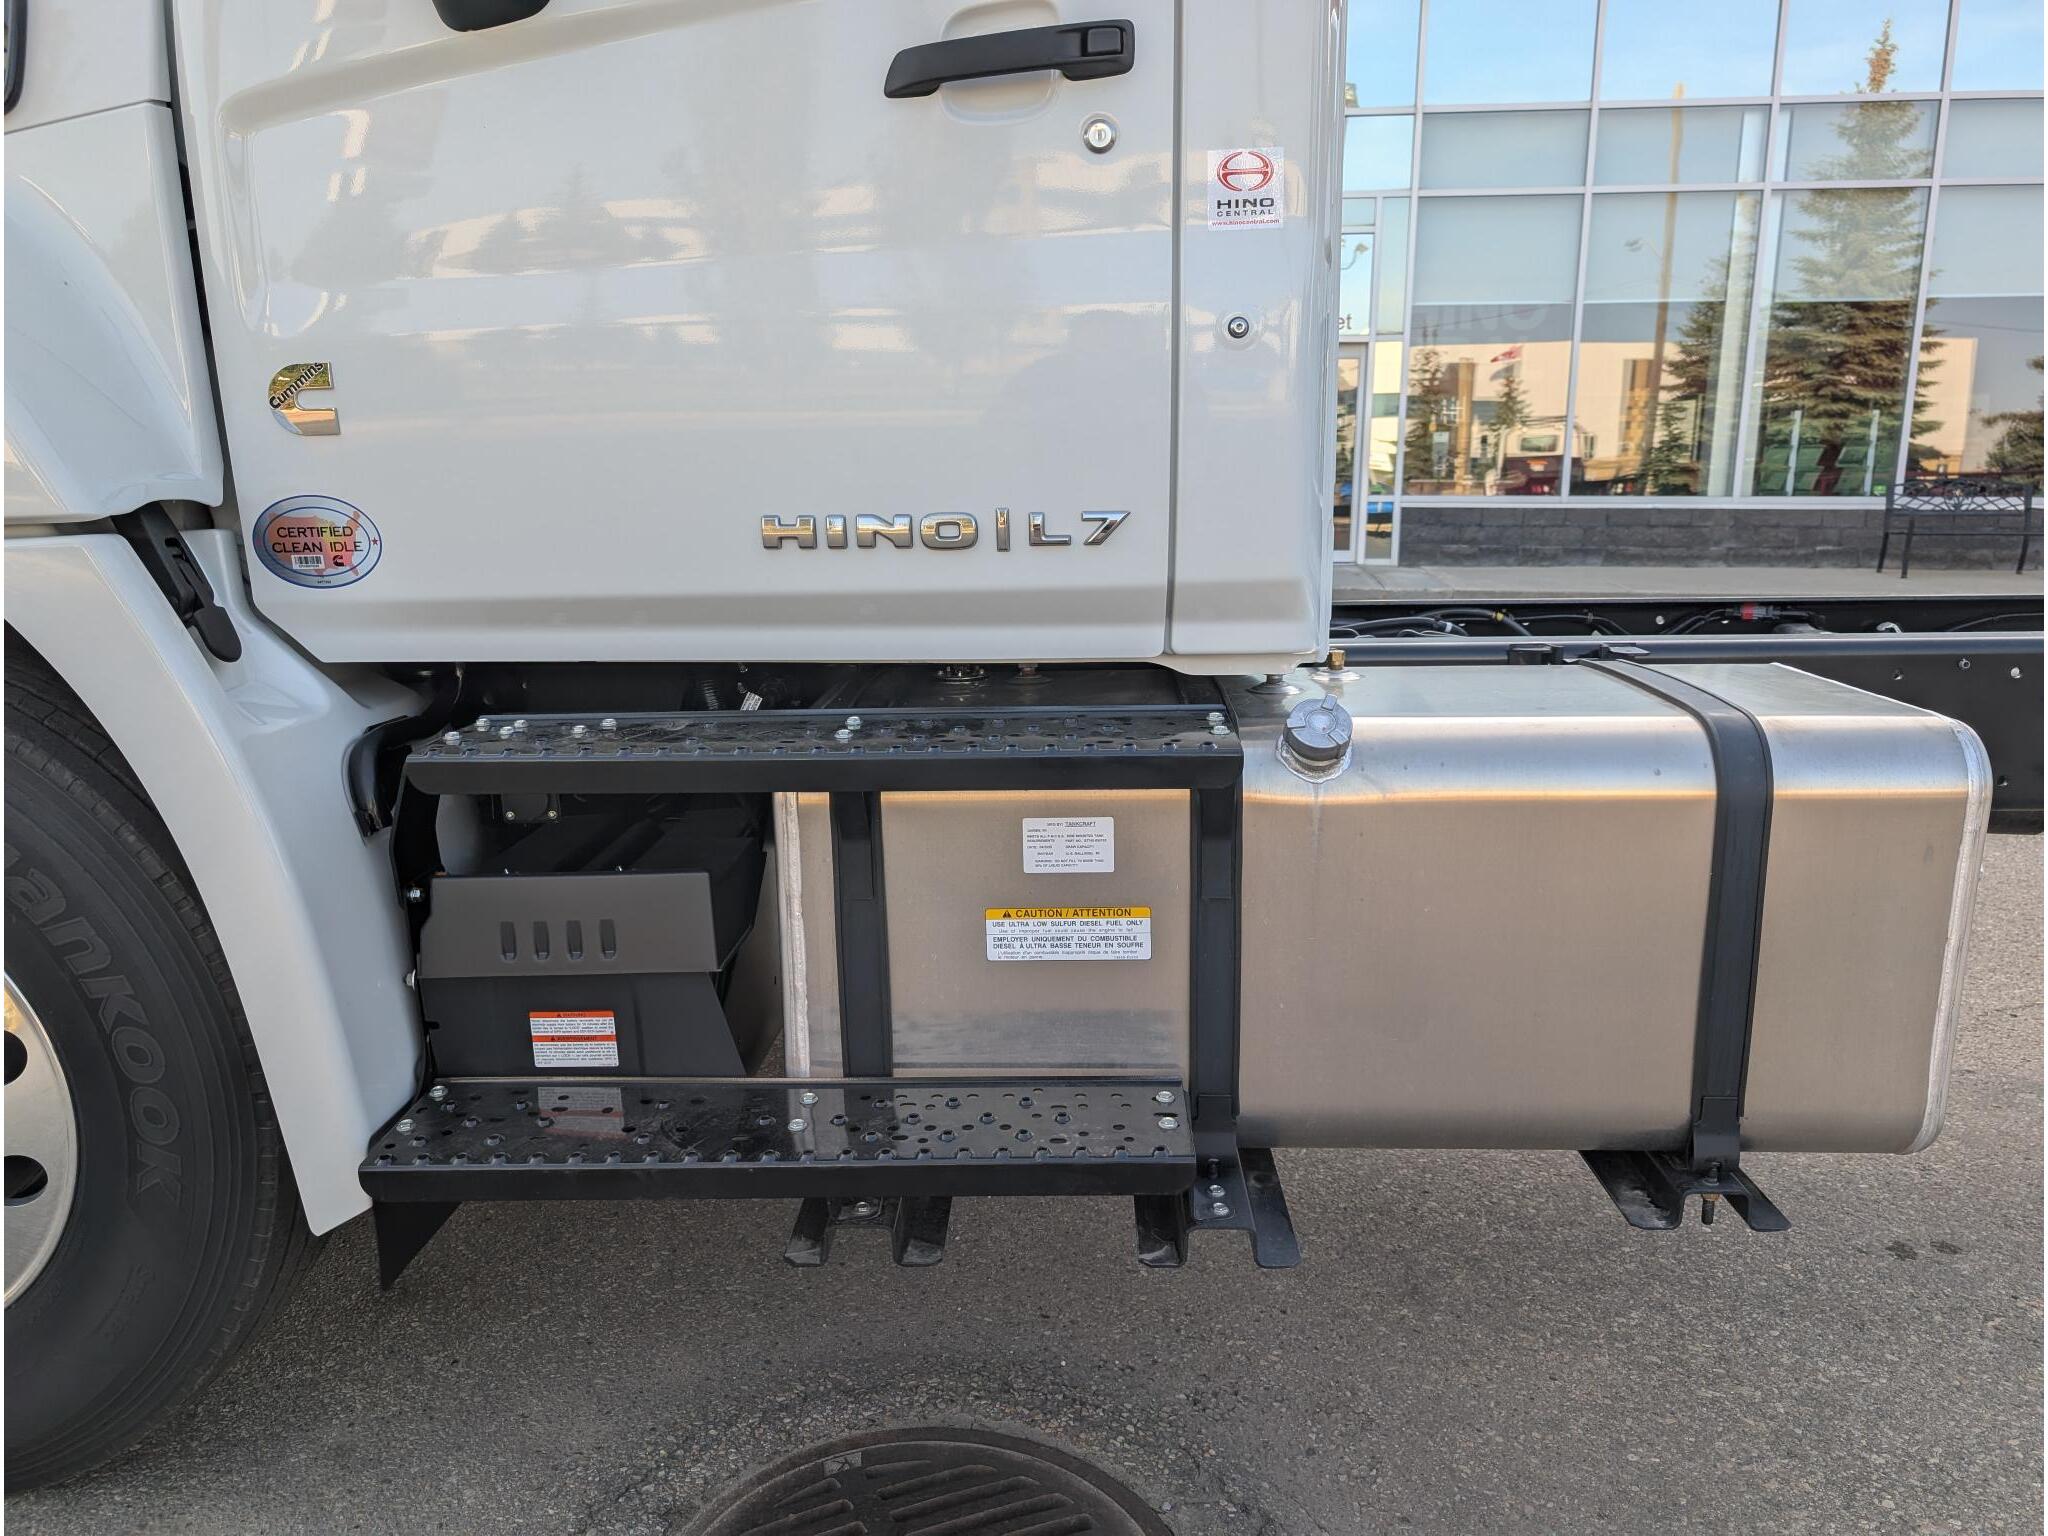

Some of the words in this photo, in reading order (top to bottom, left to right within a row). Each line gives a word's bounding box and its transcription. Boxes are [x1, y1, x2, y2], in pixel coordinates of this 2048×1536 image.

[1217, 198, 1274, 209] HINO
[1217, 209, 1274, 217] CENTRAL
[1212, 218, 1280, 227] www.hinocentral.com
[269, 362, 324, 409] Cummins
[277, 526, 353, 538] CERTIFIED
[761, 511, 979, 550] HINO
[272, 541, 323, 553] CLEAN
[329, 541, 364, 552] IDLE
[1016, 909, 1062, 918] CAUTION
[1072, 908, 1132, 917] ATTENTION
[4, 843, 182, 1206] ankook
